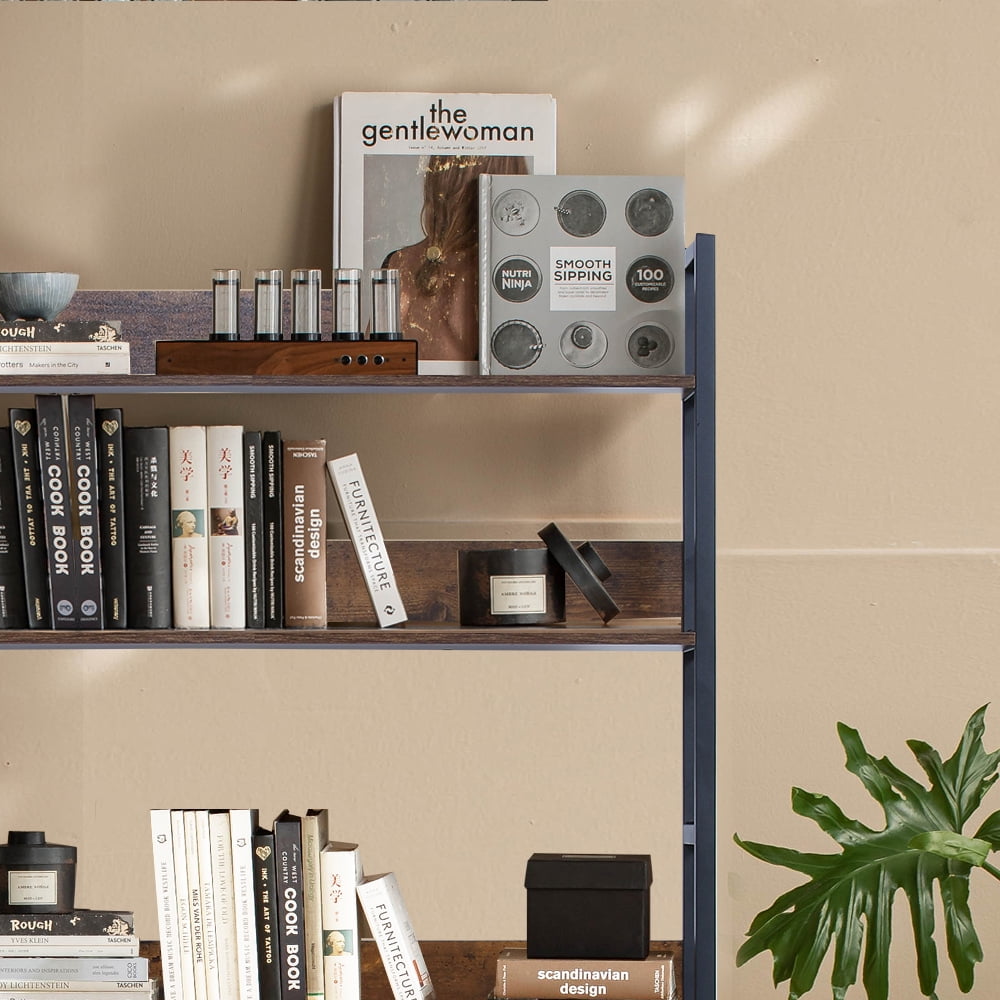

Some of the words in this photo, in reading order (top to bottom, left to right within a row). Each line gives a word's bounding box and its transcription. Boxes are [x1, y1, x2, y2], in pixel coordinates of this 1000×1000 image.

[429, 98, 467, 124] the
[361, 115, 535, 148] gentlewoman
[502, 269, 532, 279] NUTRI
[555, 259, 612, 270] SMOOTH
[553, 270, 614, 282] SIPPING
[635, 268, 665, 282] 100
[502, 278, 533, 292] NINJA
[68, 362, 79, 370] City
[107, 443, 115, 458] INK
[179, 449, 194, 482] 美学
[218, 447, 233, 480] 美学
[108, 467, 116, 482] THE
[76, 465, 93, 517] COOK
[110, 517, 118, 546] TATTOO
[291, 484, 305, 583] scandinavian
[307, 508, 323, 559] design
[348, 480, 391, 591] FURNITECTURE
[79, 526, 95, 575] BOOK
[284, 887, 299, 936] COOK
[10, 919, 53, 932] ROUGH
[194, 925, 202, 942] DER
[195, 942, 204, 964] ROHE
[286, 944, 301, 991] BOOK
[537, 968, 629, 981] scandinavian
[10, 981, 70, 990] LICHTENSTEIN
[559, 983, 607, 997] design
